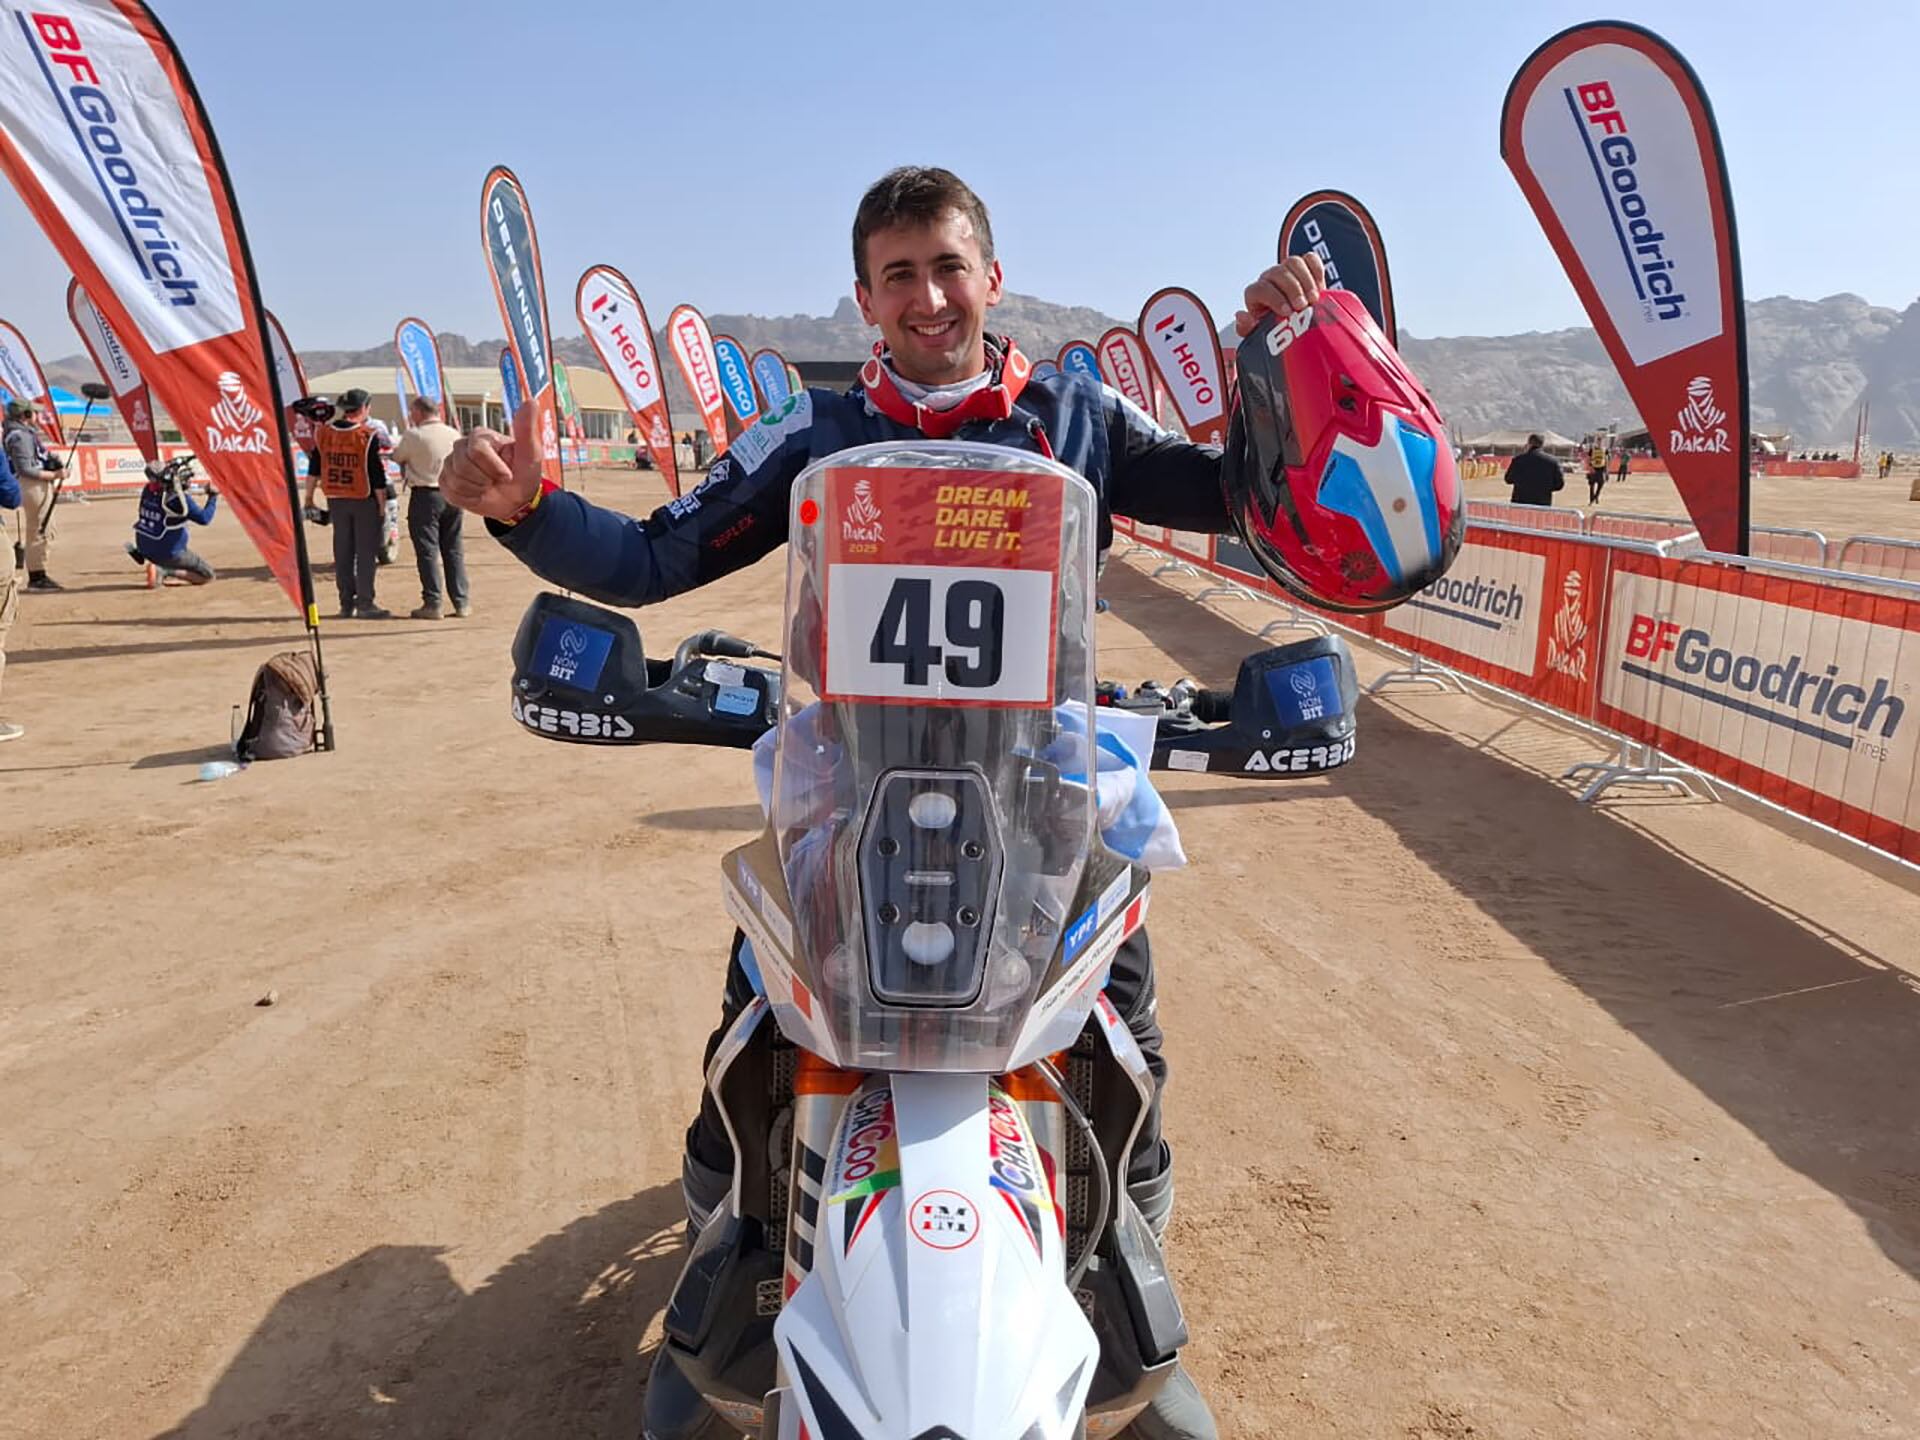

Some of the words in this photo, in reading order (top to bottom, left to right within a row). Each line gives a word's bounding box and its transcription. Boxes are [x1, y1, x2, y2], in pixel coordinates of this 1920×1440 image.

[31, 12, 198, 307] BFGoodrich
[1577, 81, 1686, 320] BFGoodrich
[492, 197, 545, 379] DEFENDER
[610, 322, 651, 389] Hero
[680, 322, 719, 405] MOTUL
[715, 344, 752, 412] aramco
[1173, 343, 1214, 405] Hero
[207, 425, 273, 455] DAKAR
[1670, 428, 1731, 455] DAKAR
[936, 486, 1032, 508] DREAM.
[843, 524, 885, 542] DAKAR
[936, 509, 1009, 528] DARE.
[849, 544, 878, 553] 2025
[934, 530, 988, 548] LIVE
[995, 532, 1021, 549] IT.
[870, 578, 1004, 688] 49
[549, 665, 575, 680] BIT
[1547, 638, 1588, 683] DAKAR
[1626, 614, 1905, 739] BFGoodrich
[1302, 706, 1323, 720] BIT
[1852, 734, 1889, 763] Tires
[1069, 913, 1095, 947] YPF
